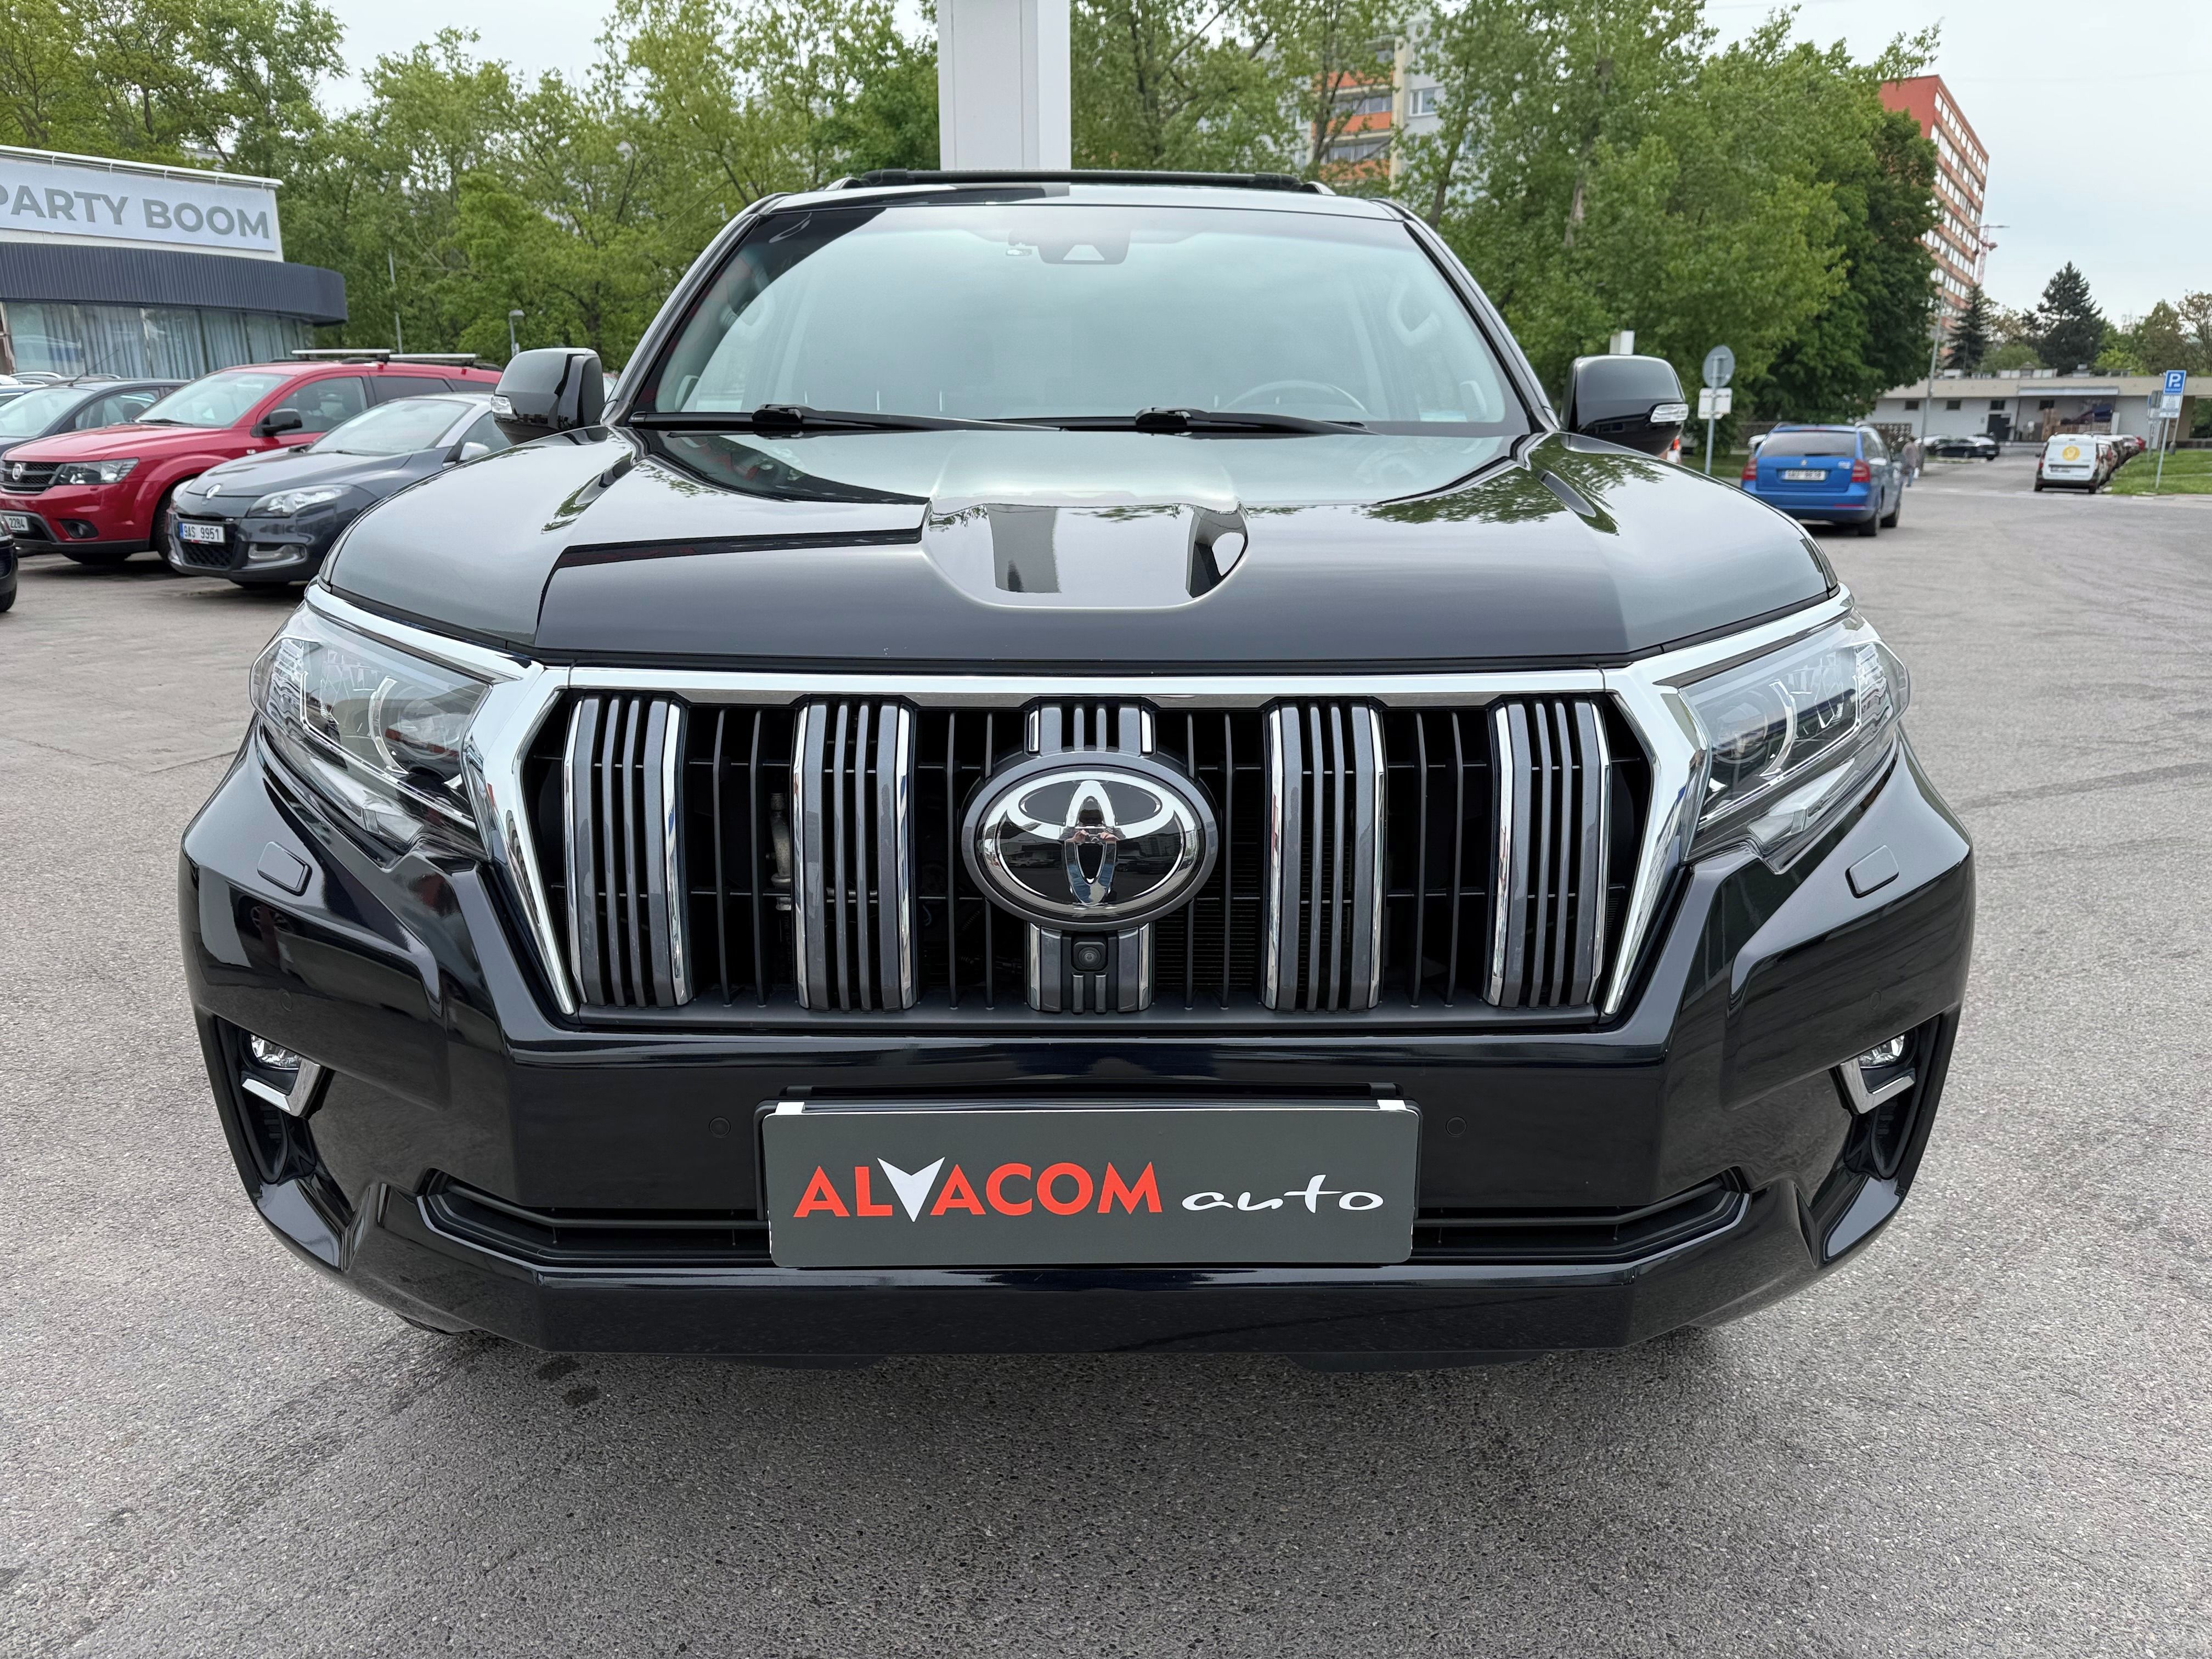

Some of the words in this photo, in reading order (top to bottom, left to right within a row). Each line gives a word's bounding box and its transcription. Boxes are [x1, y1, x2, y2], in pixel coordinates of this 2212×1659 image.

[143, 198, 269, 239] BOOM
[2168, 373, 2181, 387] P
[184, 526, 195, 538] 9AS
[200, 527, 219, 540] 9951
[793, 1156, 1163, 1222] ALVACOM
[1181, 1174, 1384, 1214] auto
